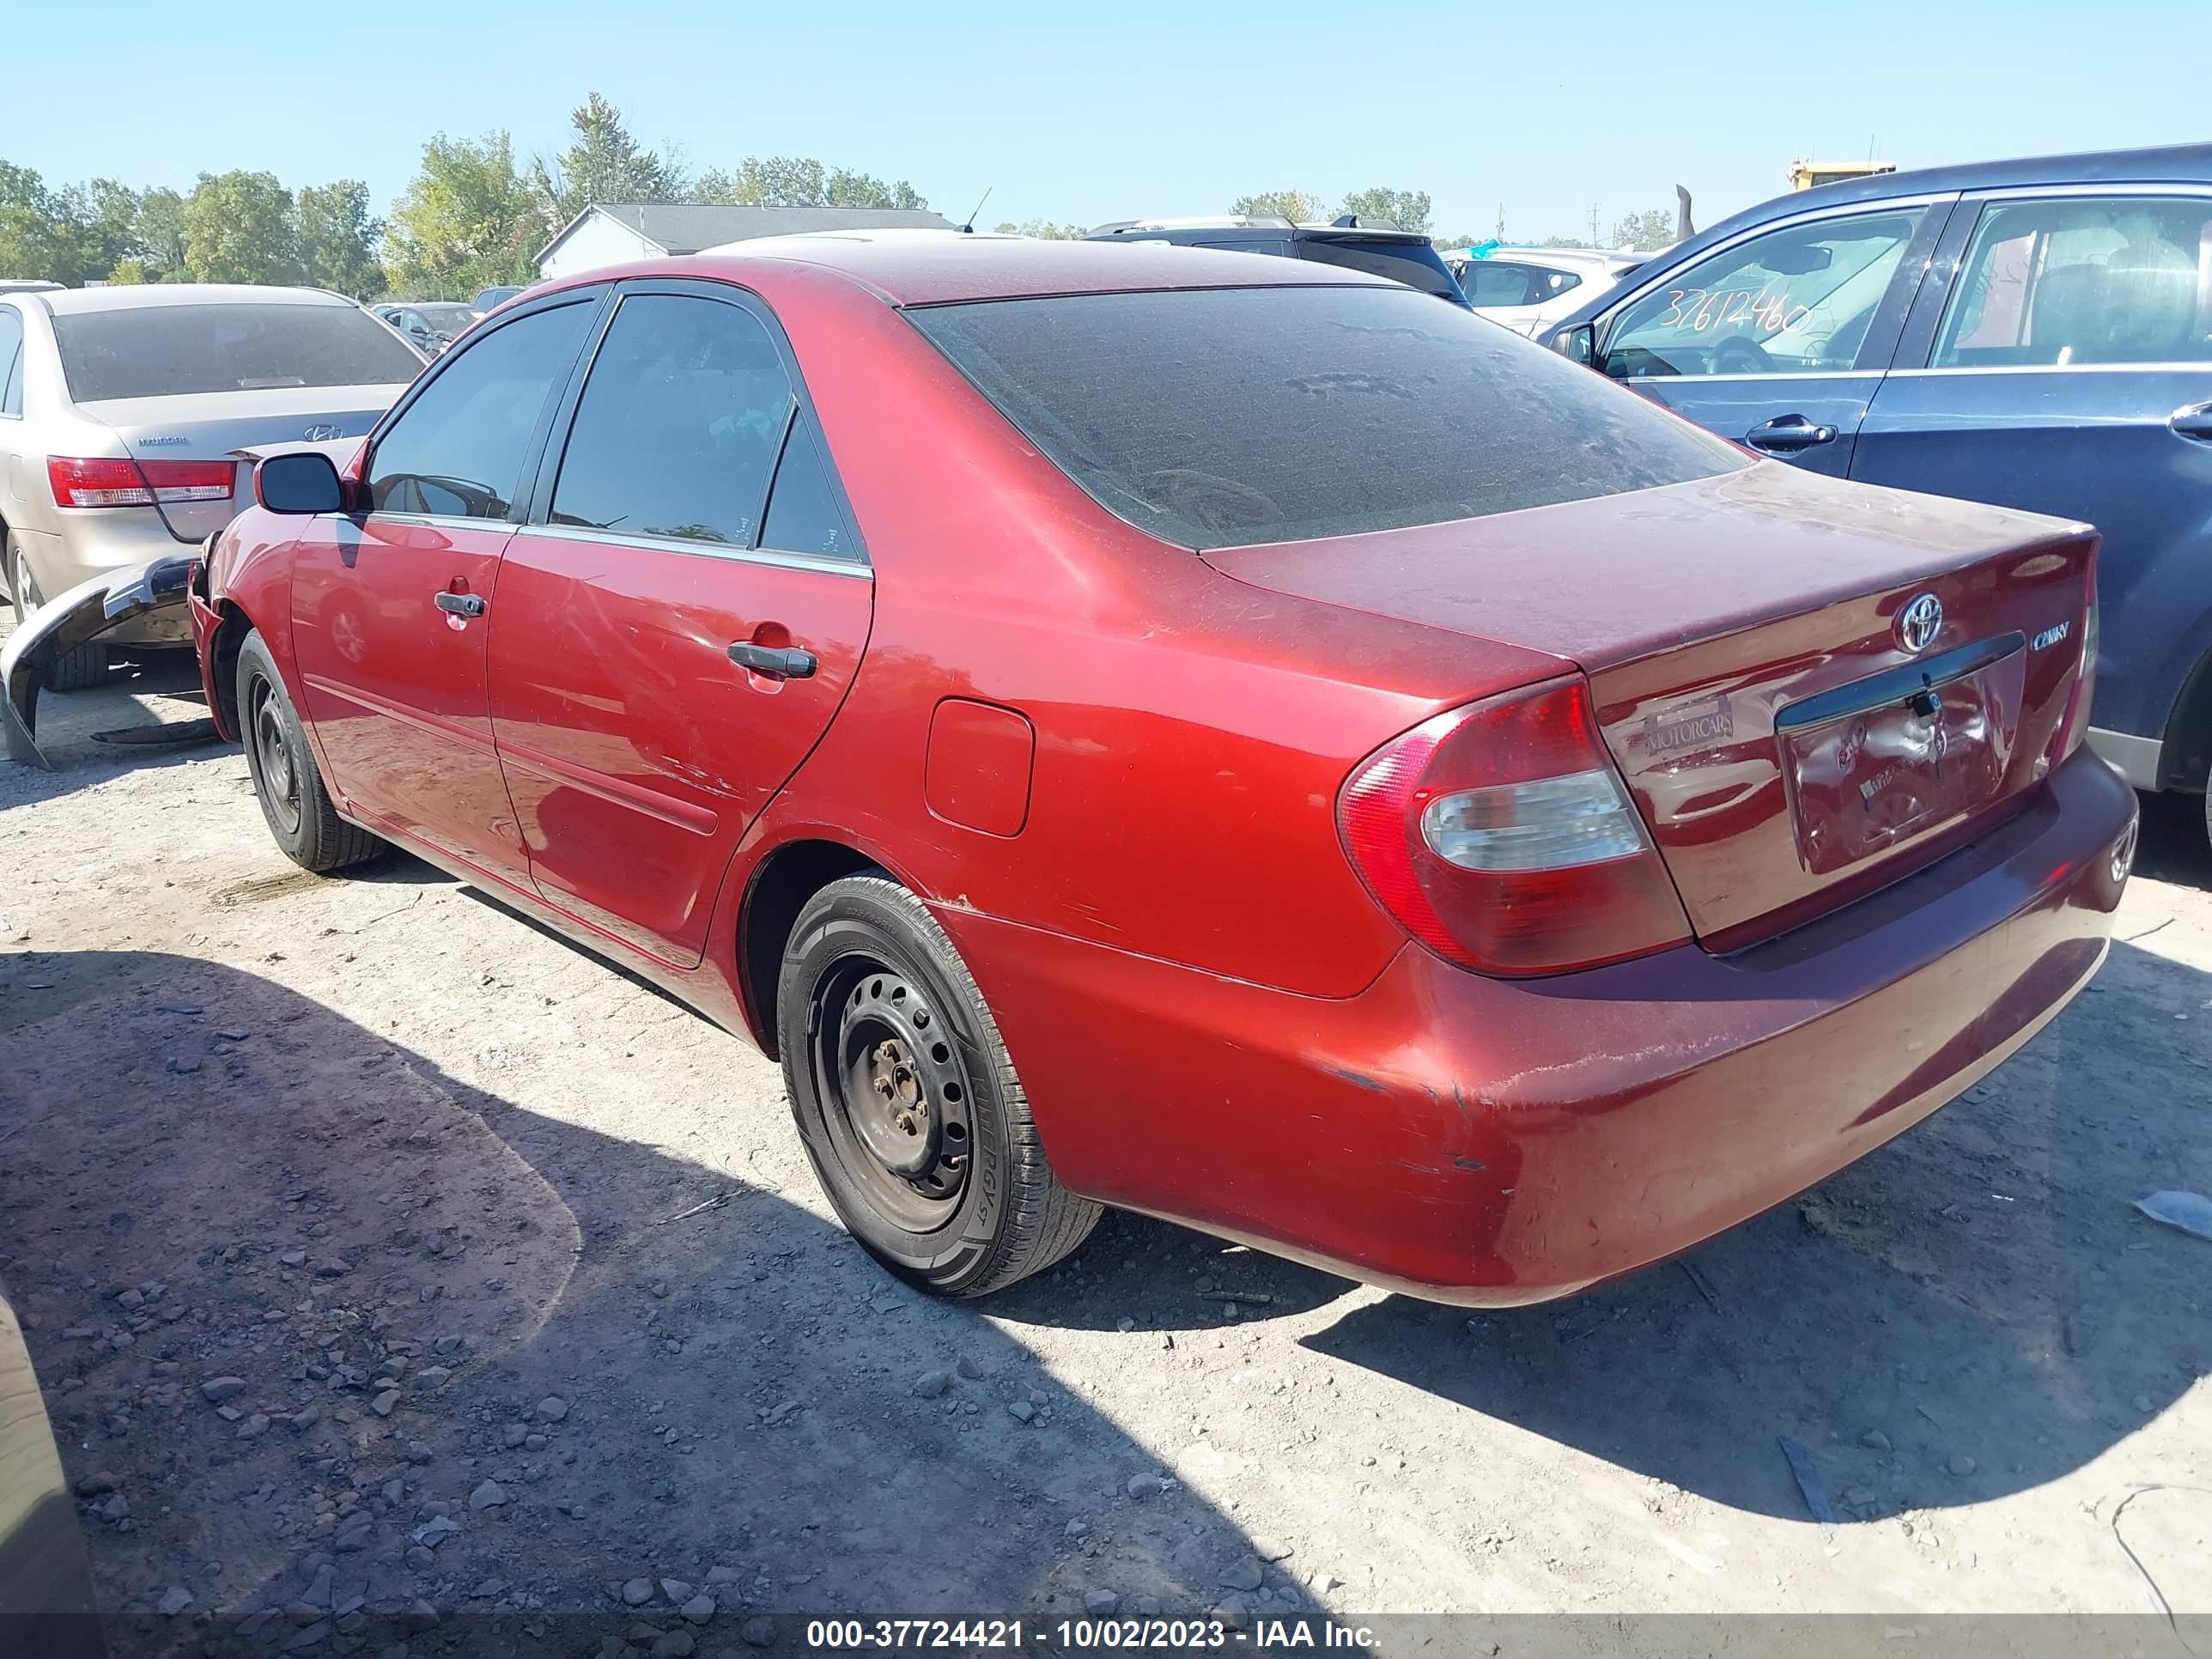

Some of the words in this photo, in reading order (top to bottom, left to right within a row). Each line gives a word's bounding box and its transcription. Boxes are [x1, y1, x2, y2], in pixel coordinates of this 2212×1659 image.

[1661, 289, 1812, 332] 37612460
[137, 436, 186, 447] HYUNDAI
[1647, 713, 1733, 750] MOTORCARS
